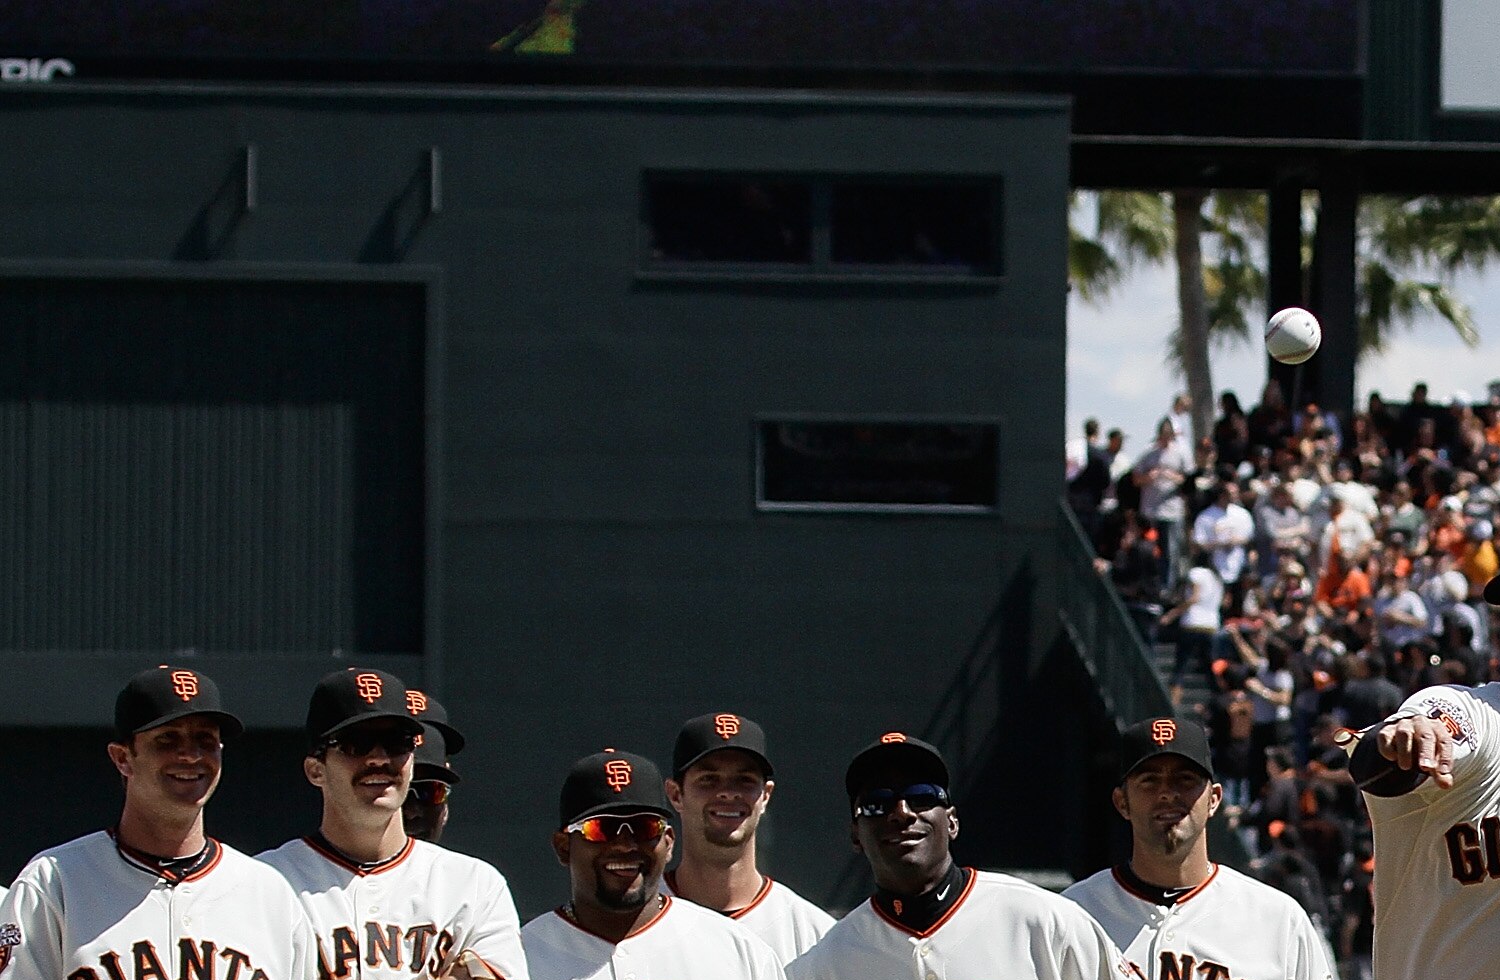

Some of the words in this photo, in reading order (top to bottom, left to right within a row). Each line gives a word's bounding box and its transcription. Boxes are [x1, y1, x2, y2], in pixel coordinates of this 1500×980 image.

[0, 58, 75, 81] RIC
[173, 670, 199, 702] SF
[356, 673, 384, 703] SF
[714, 713, 741, 739] SF
[1151, 718, 1177, 746] SF
[604, 759, 632, 793] SF
